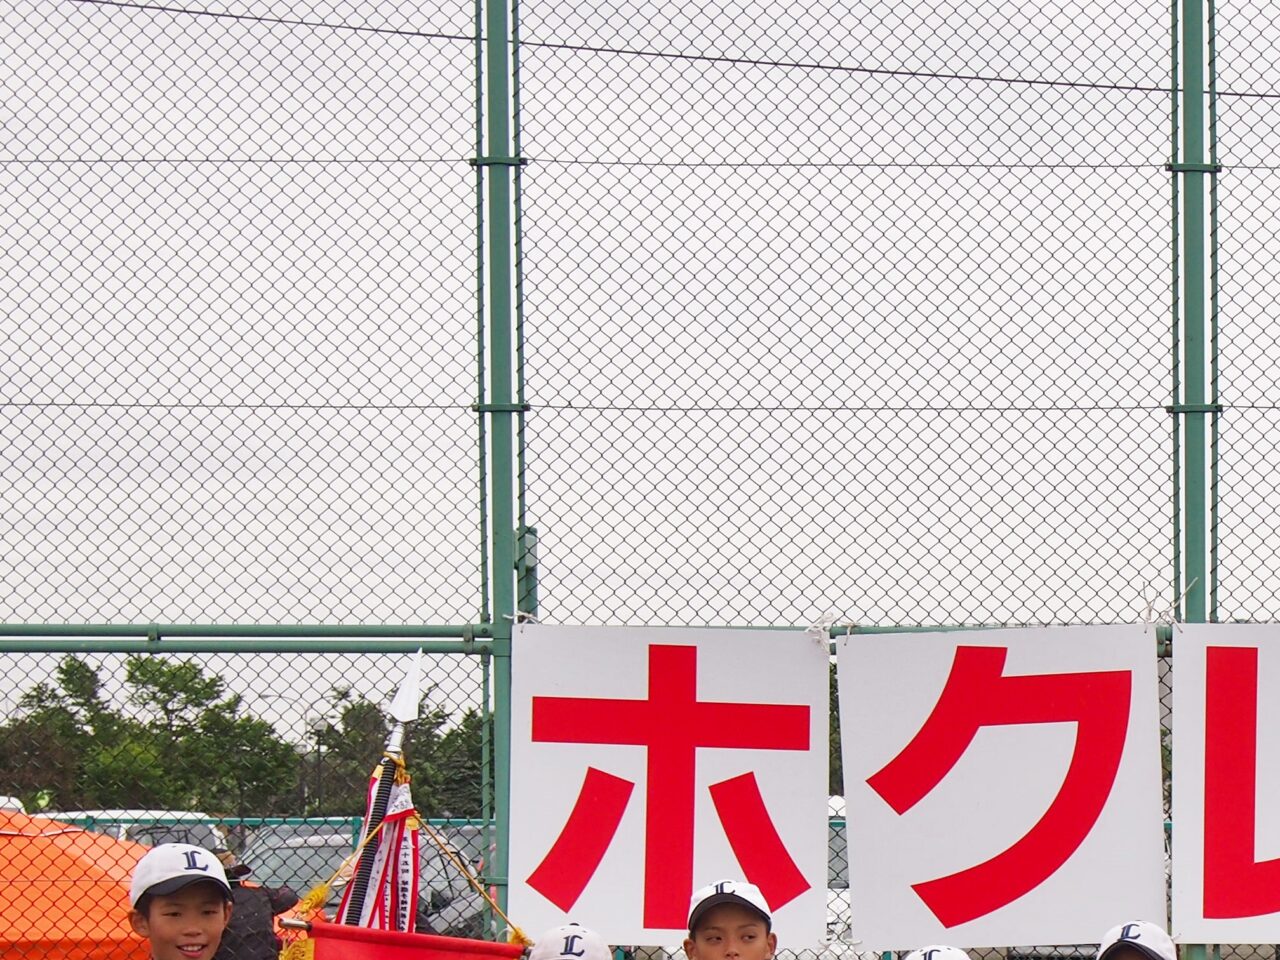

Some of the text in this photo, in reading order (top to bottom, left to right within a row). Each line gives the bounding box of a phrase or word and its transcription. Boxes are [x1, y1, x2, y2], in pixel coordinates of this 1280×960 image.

[184, 851, 208, 872] L
[1118, 924, 1141, 942] L
[560, 934, 585, 957] L
